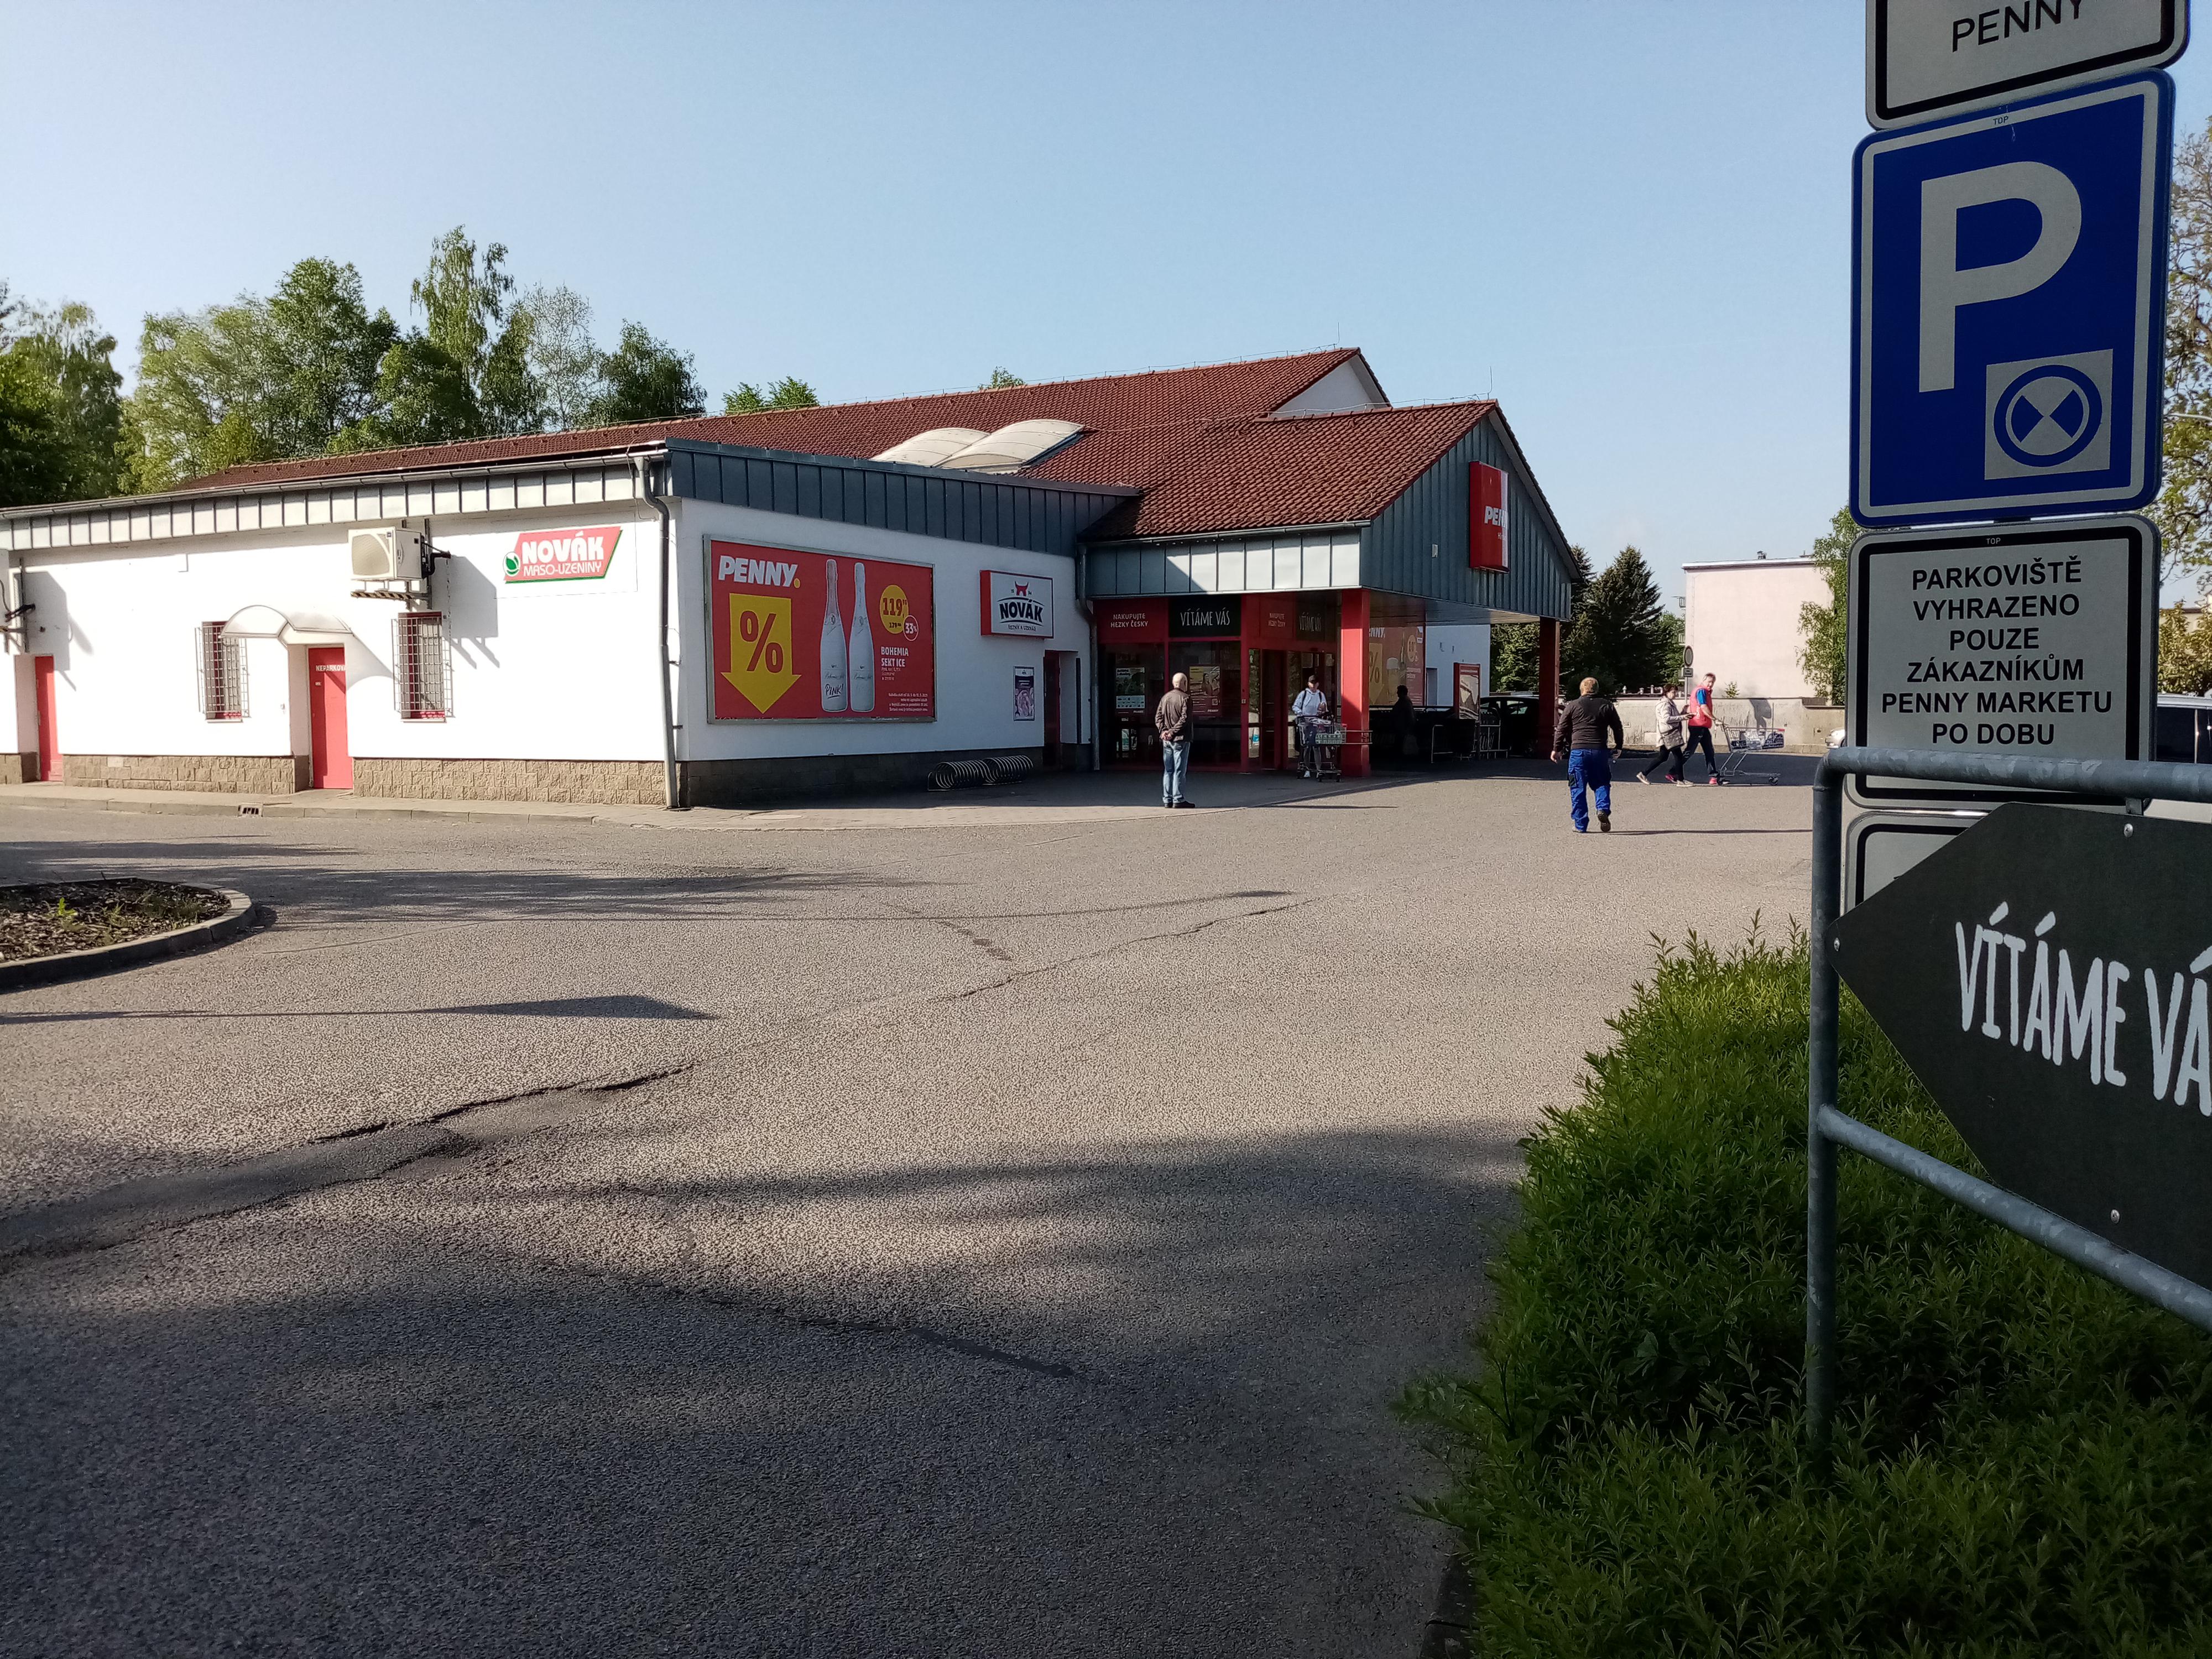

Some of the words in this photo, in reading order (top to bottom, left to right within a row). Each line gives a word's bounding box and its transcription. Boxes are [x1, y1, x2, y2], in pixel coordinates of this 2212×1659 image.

[1992, 116, 2008, 125] TOP
[1919, 161, 2082, 393] P
[521, 531, 604, 564] NOVÁK
[523, 561, 602, 576] MASO-UZENINY
[1912, 555, 2082, 591] PARKOVIŠTĚ
[999, 599, 1044, 623] NOVÁK
[1180, 608, 1213, 627] VÍTÁME
[1215, 607, 1230, 626] VÁS
[1912, 593, 2080, 621] VYHRAZENO
[880, 646, 909, 656] BOHEMIA
[1949, 627, 2040, 651] POUZE
[881, 658, 895, 667] SEKT
[896, 659, 905, 667] ICE
[1907, 653, 2084, 683] ZÁKAZNÍKŮM
[1882, 692, 1969, 713] PENNY
[1976, 691, 2112, 713] MARKETU
[1932, 723, 1968, 744] PO
[1977, 723, 2054, 745] DOBU
[1955, 901, 2130, 1087] VÍTÁME
[2144, 945, 2212, 1118] VÁ
